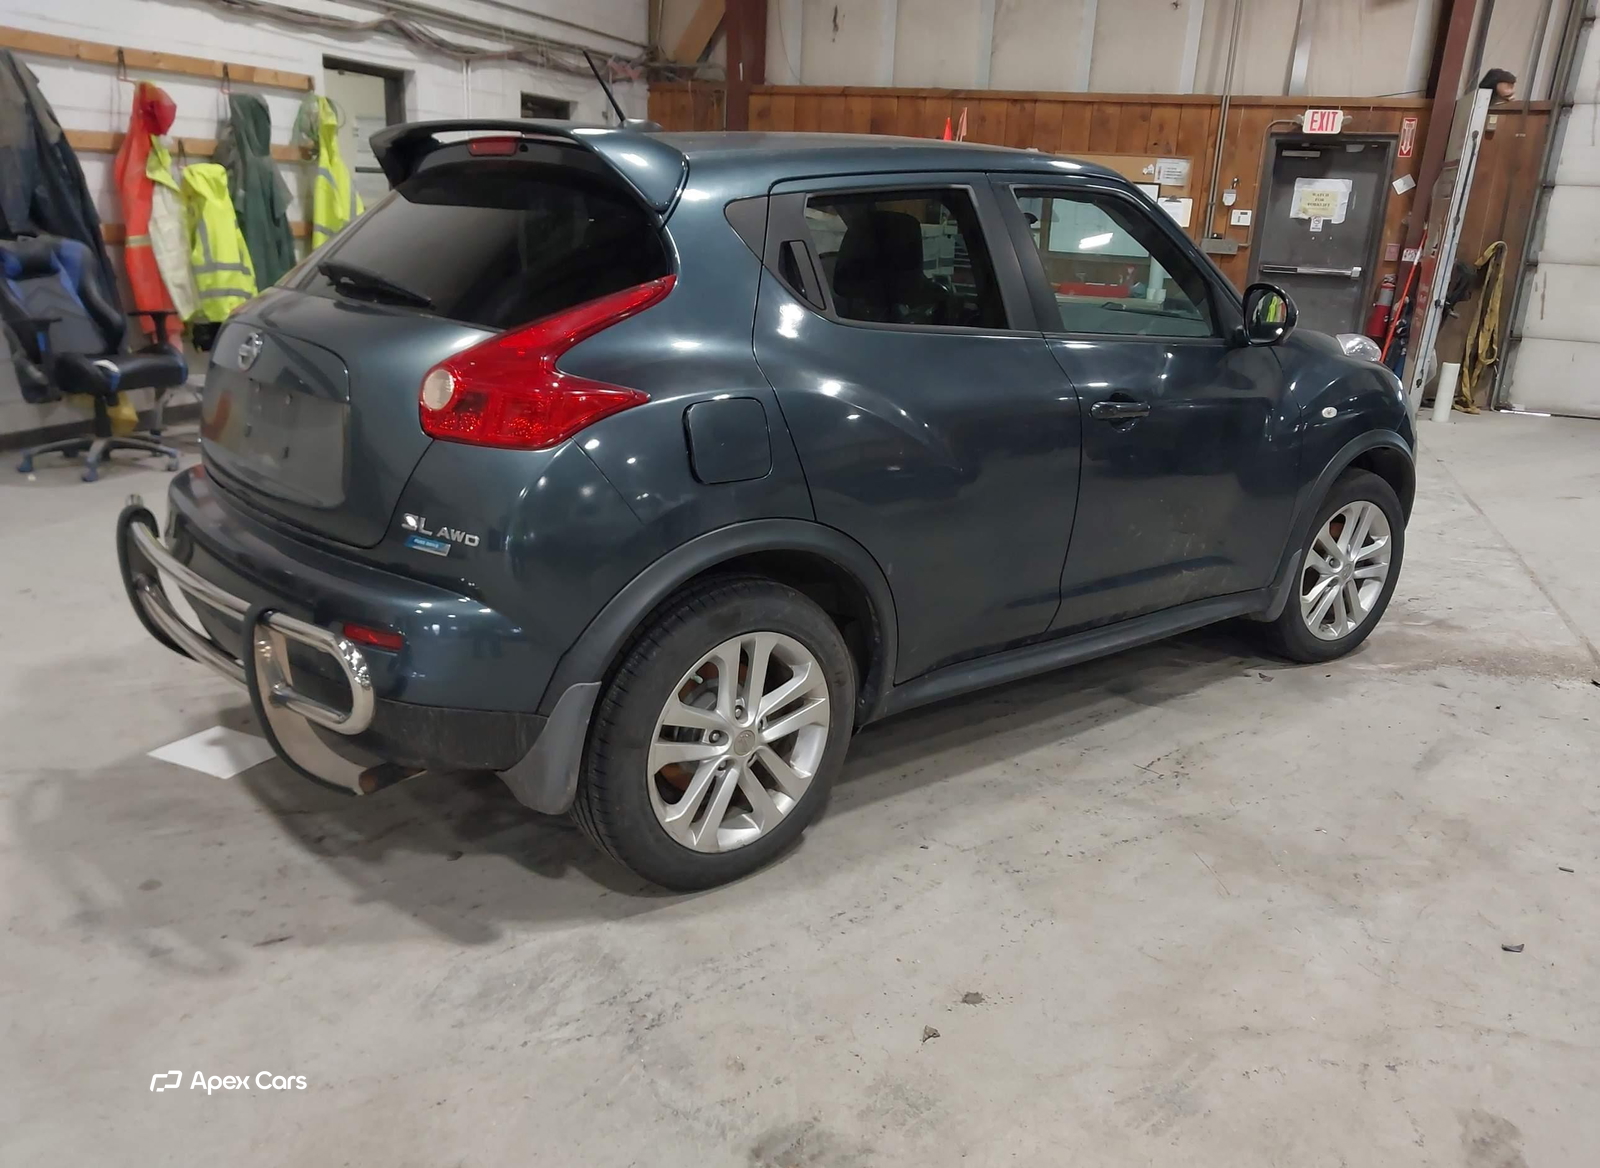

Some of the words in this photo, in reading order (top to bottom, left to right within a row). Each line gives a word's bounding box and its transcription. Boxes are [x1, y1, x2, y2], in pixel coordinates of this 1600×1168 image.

[1309, 111, 1339, 132] EXIT
[401, 512, 433, 536] SL
[436, 526, 480, 547] AWD
